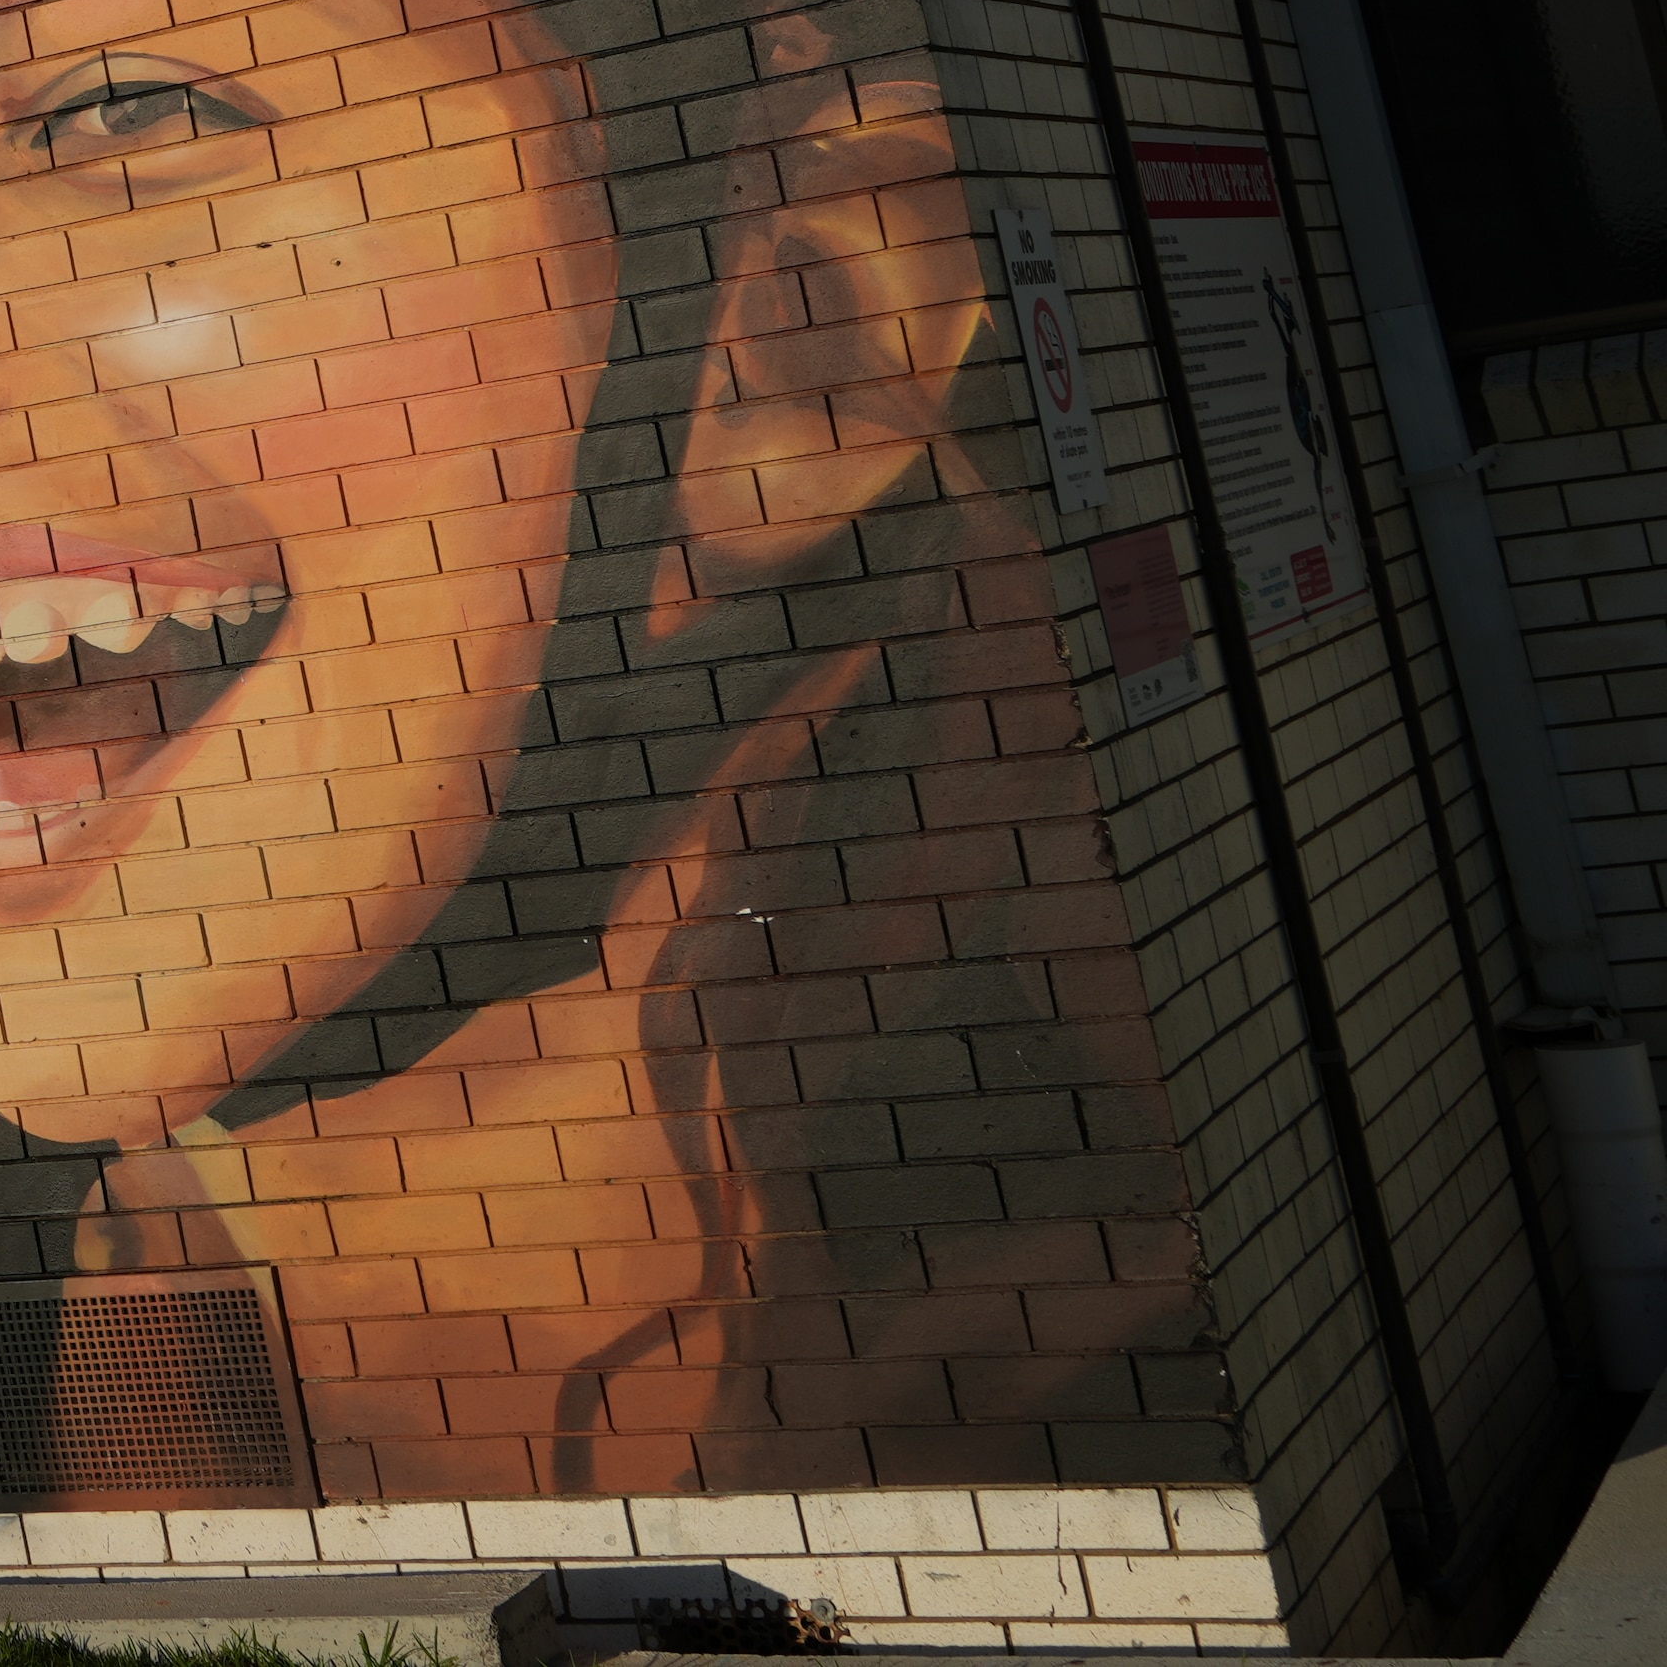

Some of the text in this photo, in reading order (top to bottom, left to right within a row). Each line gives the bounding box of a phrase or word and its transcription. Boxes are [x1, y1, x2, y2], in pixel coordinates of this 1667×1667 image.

[1137, 160, 1272, 202] ONDITIONS OF HALF PIPE USE
[1017, 229, 1035, 254] NO
[1011, 259, 1056, 286] SMOKING
